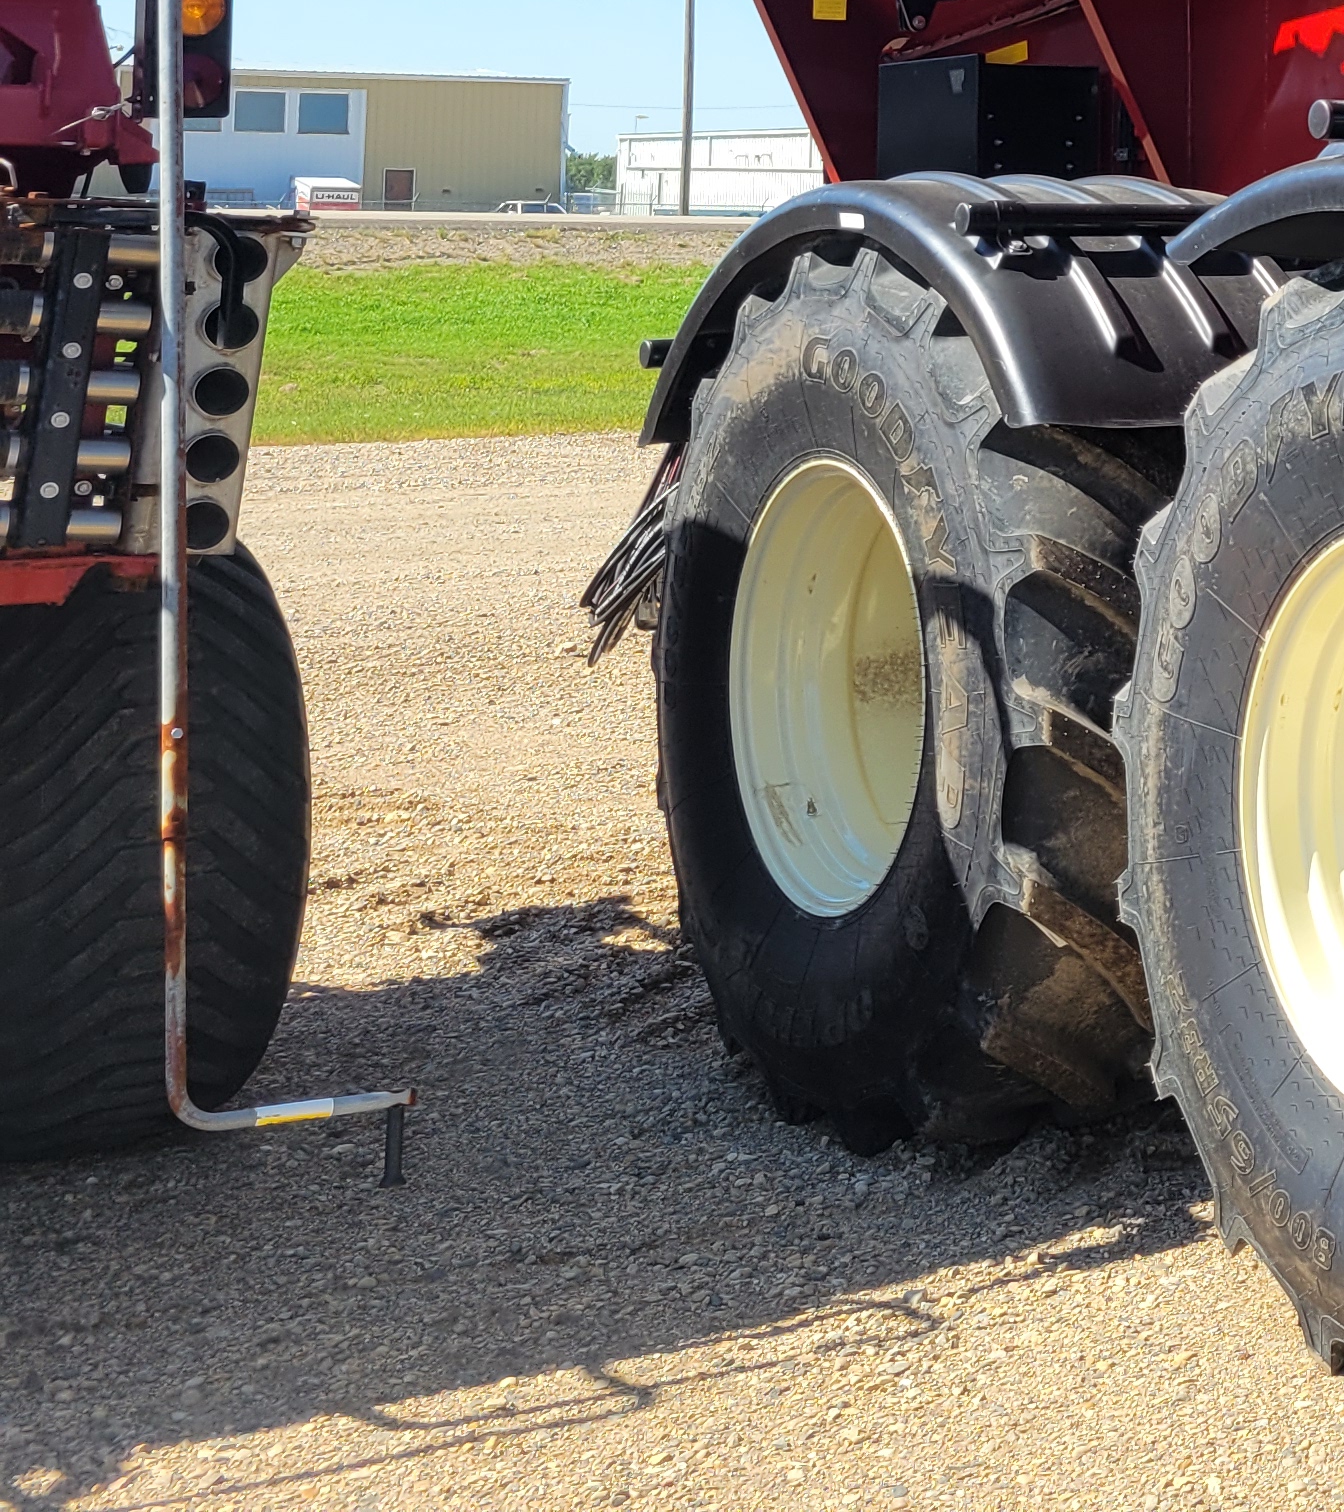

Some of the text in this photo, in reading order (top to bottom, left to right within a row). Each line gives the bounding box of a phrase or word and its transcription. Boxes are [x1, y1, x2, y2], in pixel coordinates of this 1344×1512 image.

[315, 193, 356, 201] U-HAUL
[801, 335, 968, 828] GOODYEAR
[1162, 969, 1337, 1272] 800/65R32
